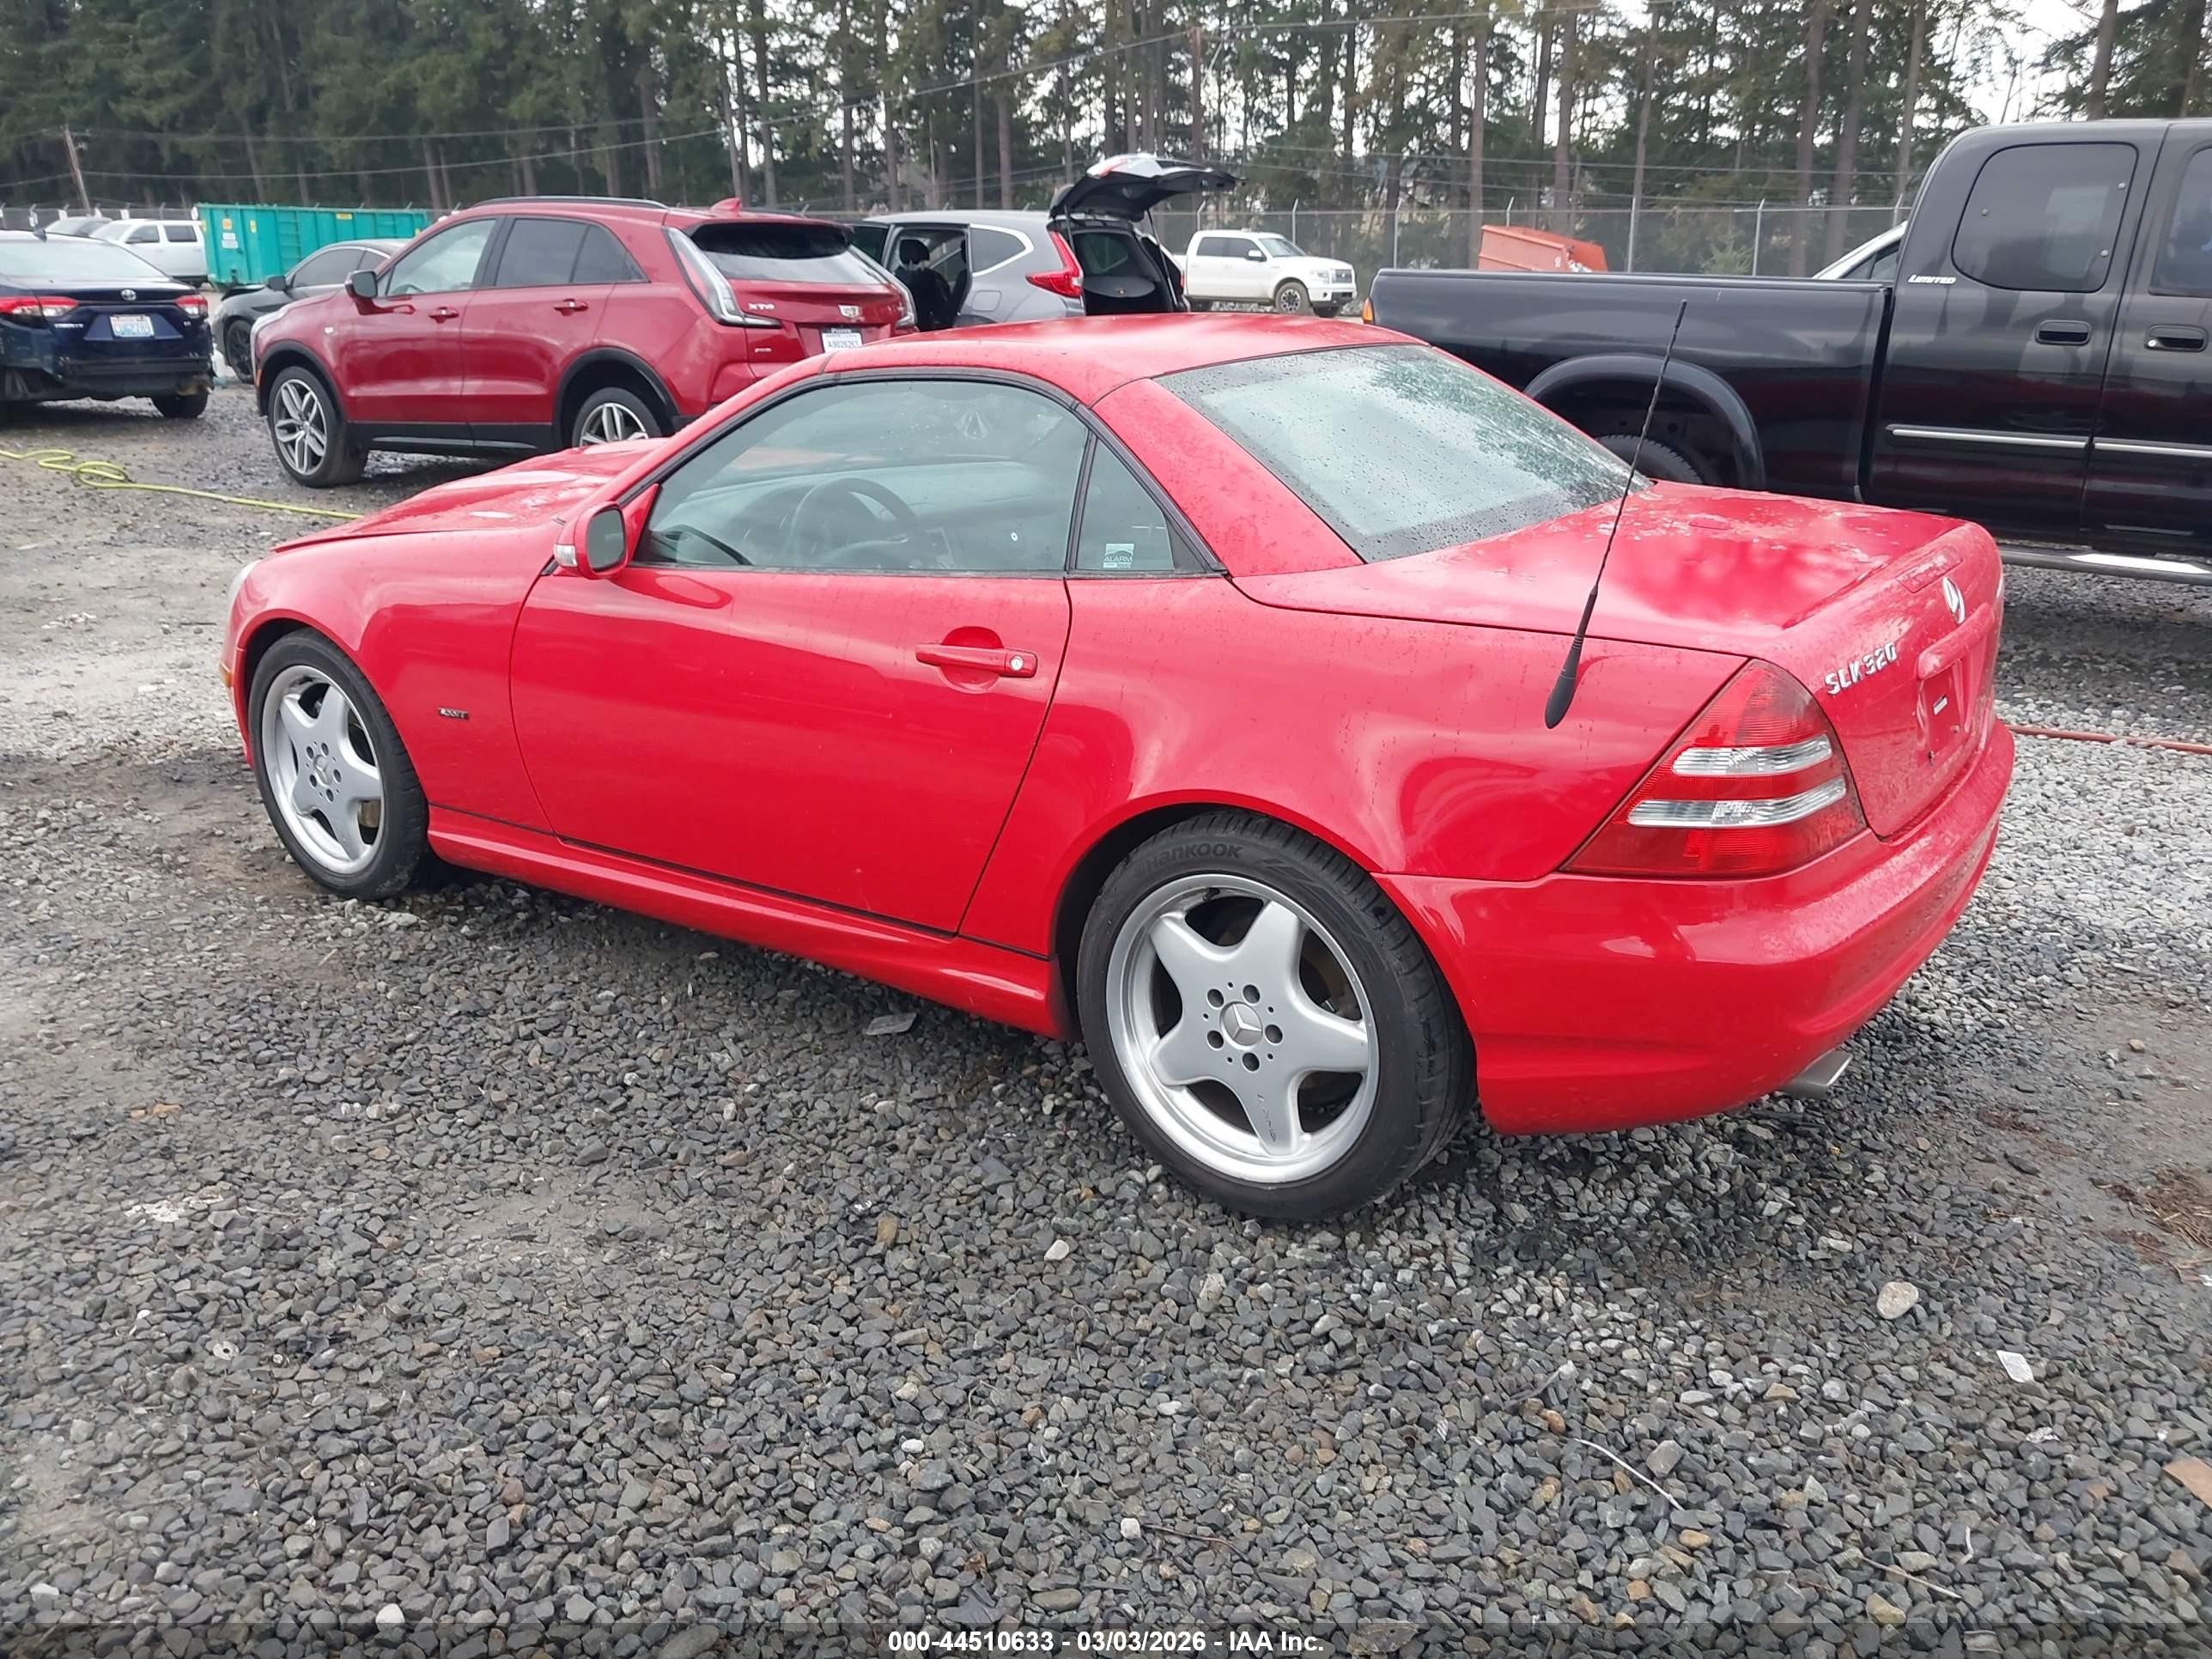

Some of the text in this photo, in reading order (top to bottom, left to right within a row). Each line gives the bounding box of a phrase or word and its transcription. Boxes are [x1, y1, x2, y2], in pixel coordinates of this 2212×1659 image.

[1908, 274, 1957, 284] LIMITED
[1824, 642, 1897, 695] SLK 320
